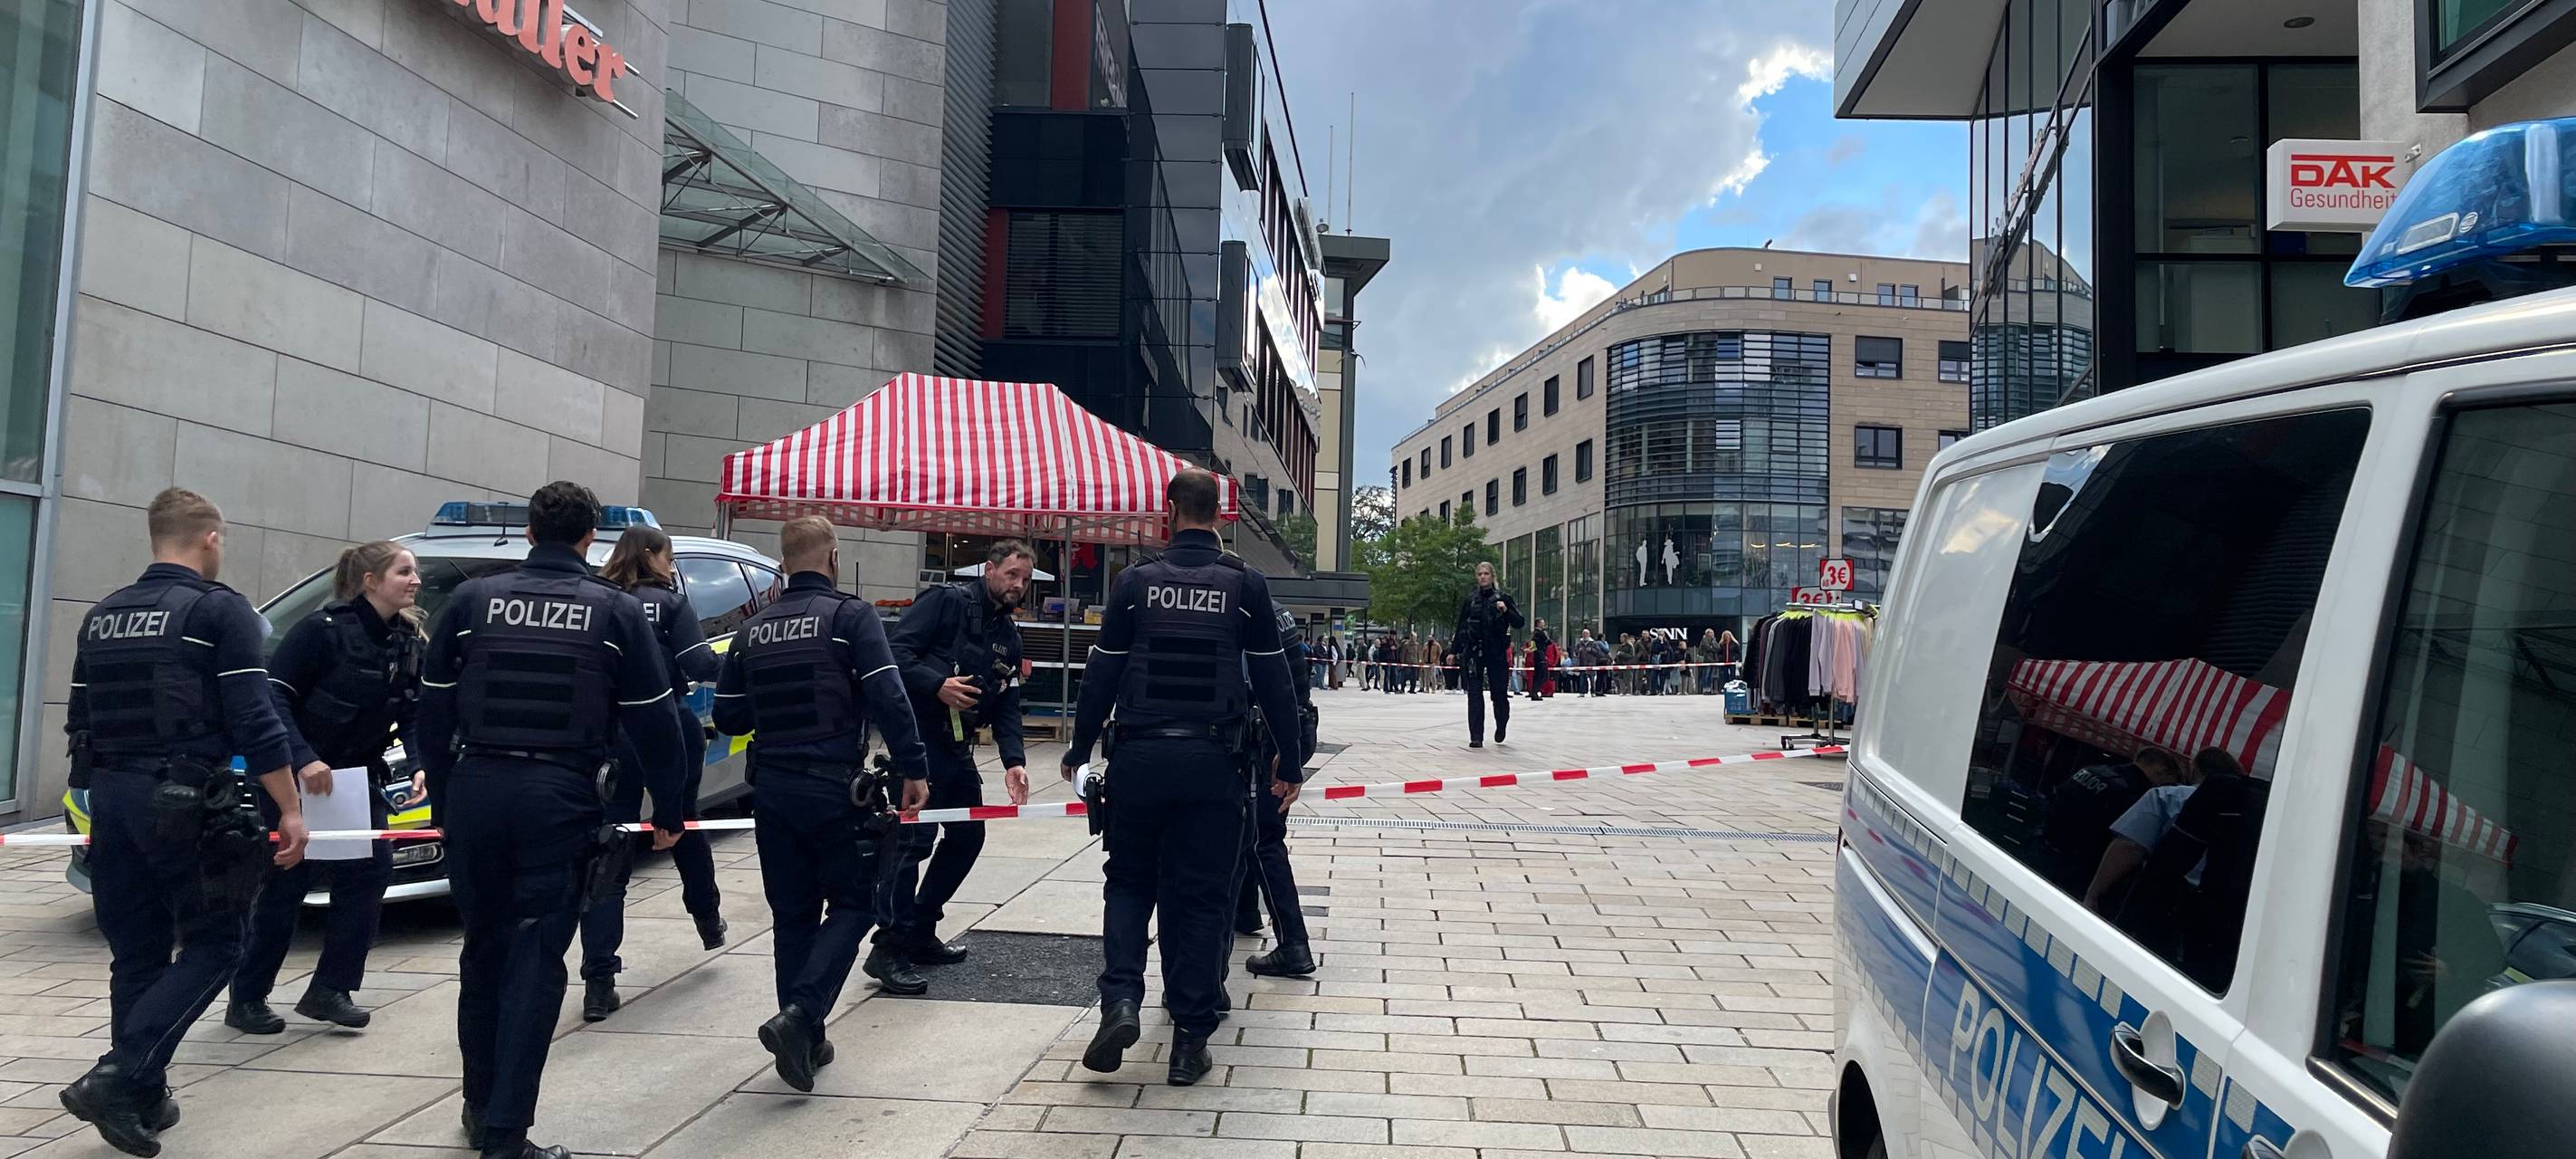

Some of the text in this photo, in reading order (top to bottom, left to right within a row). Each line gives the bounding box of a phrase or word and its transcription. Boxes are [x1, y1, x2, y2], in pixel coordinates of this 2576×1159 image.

[455, 0, 625, 102] ller
[2291, 155, 2397, 188] DAK
[1828, 566, 1846, 585] 3€
[487, 599, 592, 631] POLIZEI
[1147, 586, 1226, 614] POLIZEI
[87, 611, 170, 640] POLIZEI
[748, 617, 820, 647] POLIZEI
[1649, 627, 1689, 640] SNN
[1948, 980, 2125, 1159] POLIZ
